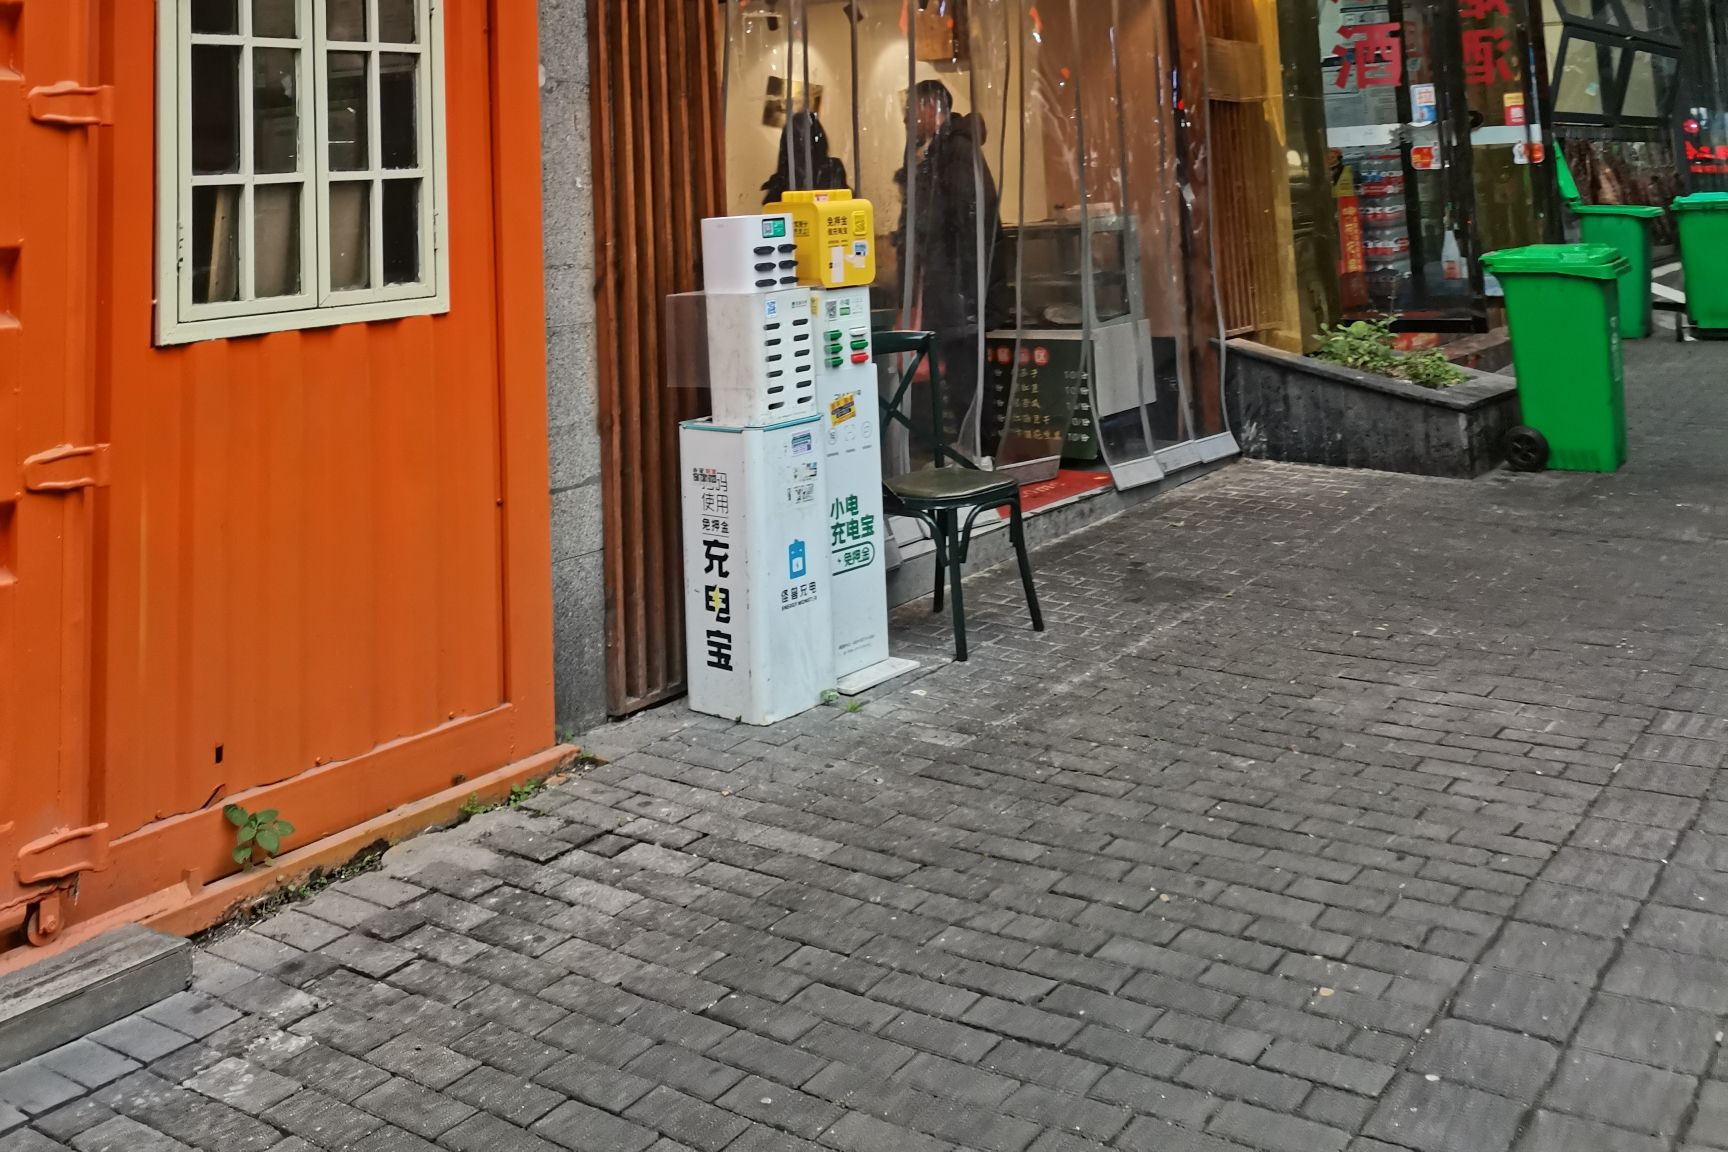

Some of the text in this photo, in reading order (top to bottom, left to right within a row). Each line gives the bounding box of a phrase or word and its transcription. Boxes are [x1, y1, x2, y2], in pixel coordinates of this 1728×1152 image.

[701, 493, 729, 514] 使用
[830, 494, 859, 520] 小电
[830, 514, 875, 546] 充电宝
[702, 539, 733, 672] 充电宝
